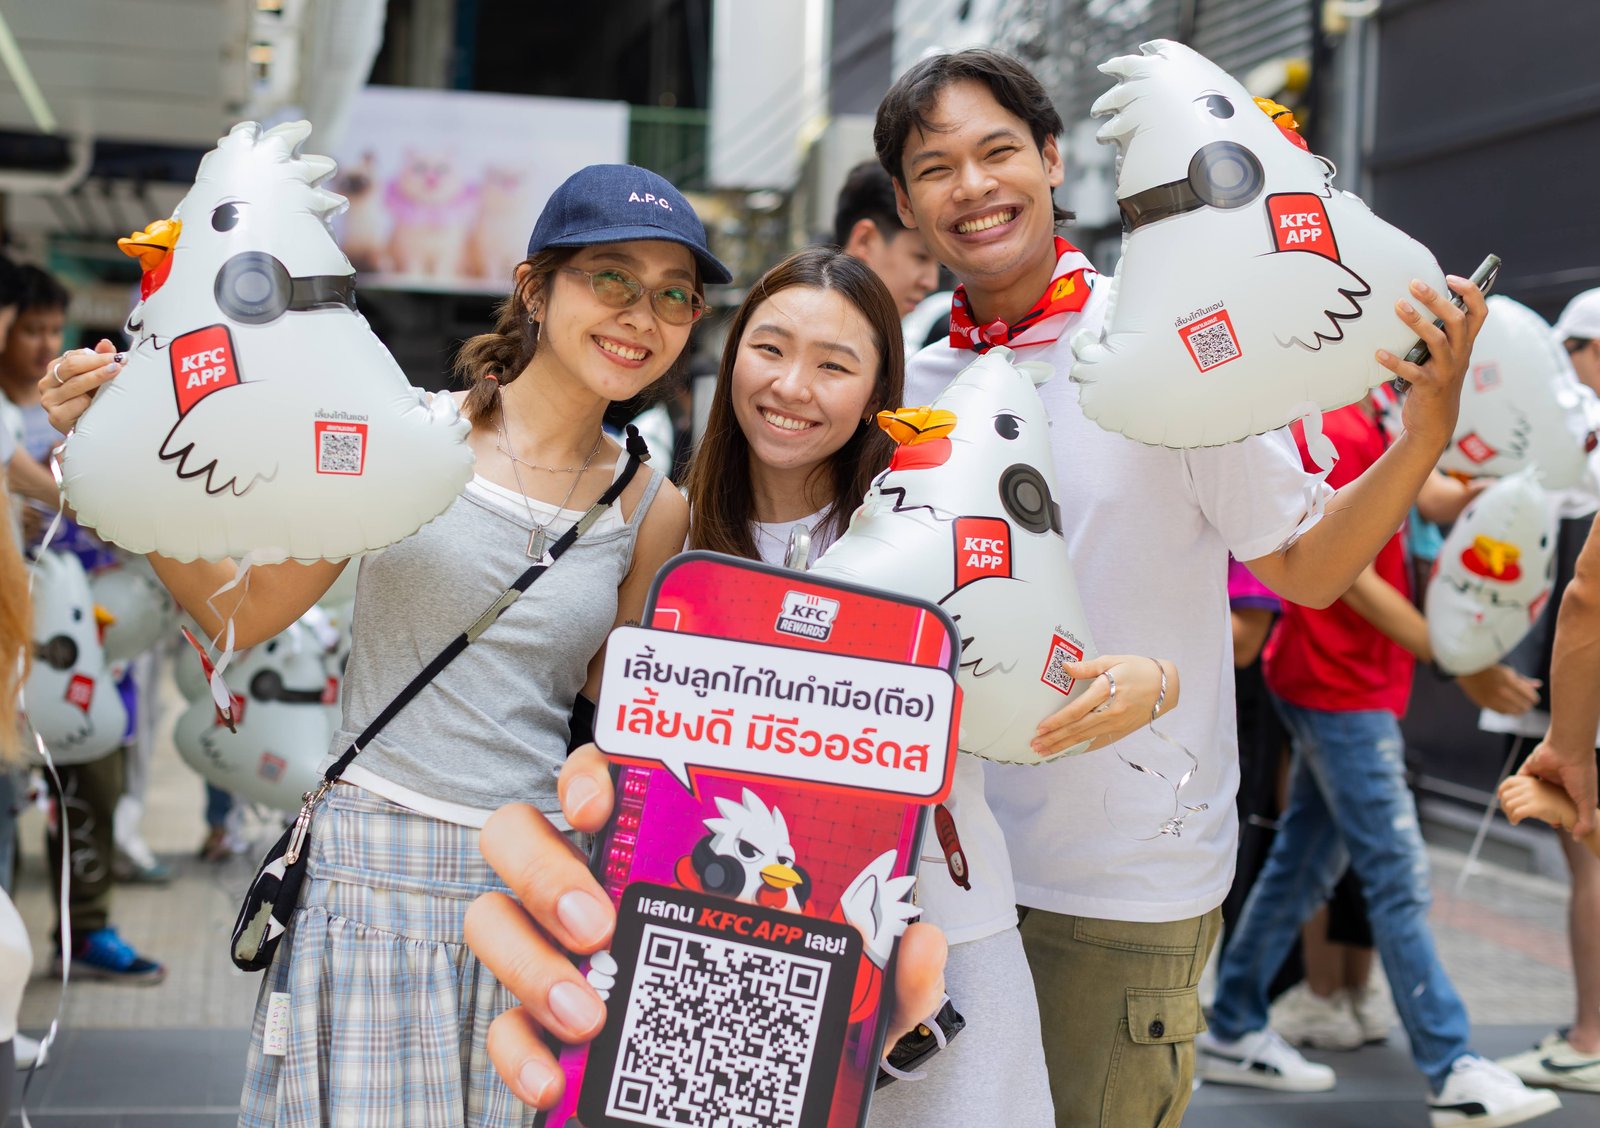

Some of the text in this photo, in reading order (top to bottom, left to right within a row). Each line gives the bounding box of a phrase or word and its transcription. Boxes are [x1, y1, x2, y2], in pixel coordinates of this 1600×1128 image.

[628, 191, 673, 212] A.P.C.
[1280, 212, 1321, 229] KFC
[1286, 228, 1322, 245] APP
[181, 347, 226, 373] KFC
[186, 365, 227, 390] APP
[963, 537, 1004, 554] KFC
[966, 553, 1003, 569] APP
[791, 604, 828, 622] KFC
[780, 618, 827, 639] REWARDS
[623, 645, 935, 722] เลี้ยงลูกไก่ในกำมือ(ถือ)
[616, 687, 931, 773] เลี้ยงดี มีรีวอร์ดส
[637, 896, 848, 956] แสกน KFC APP เลย!
